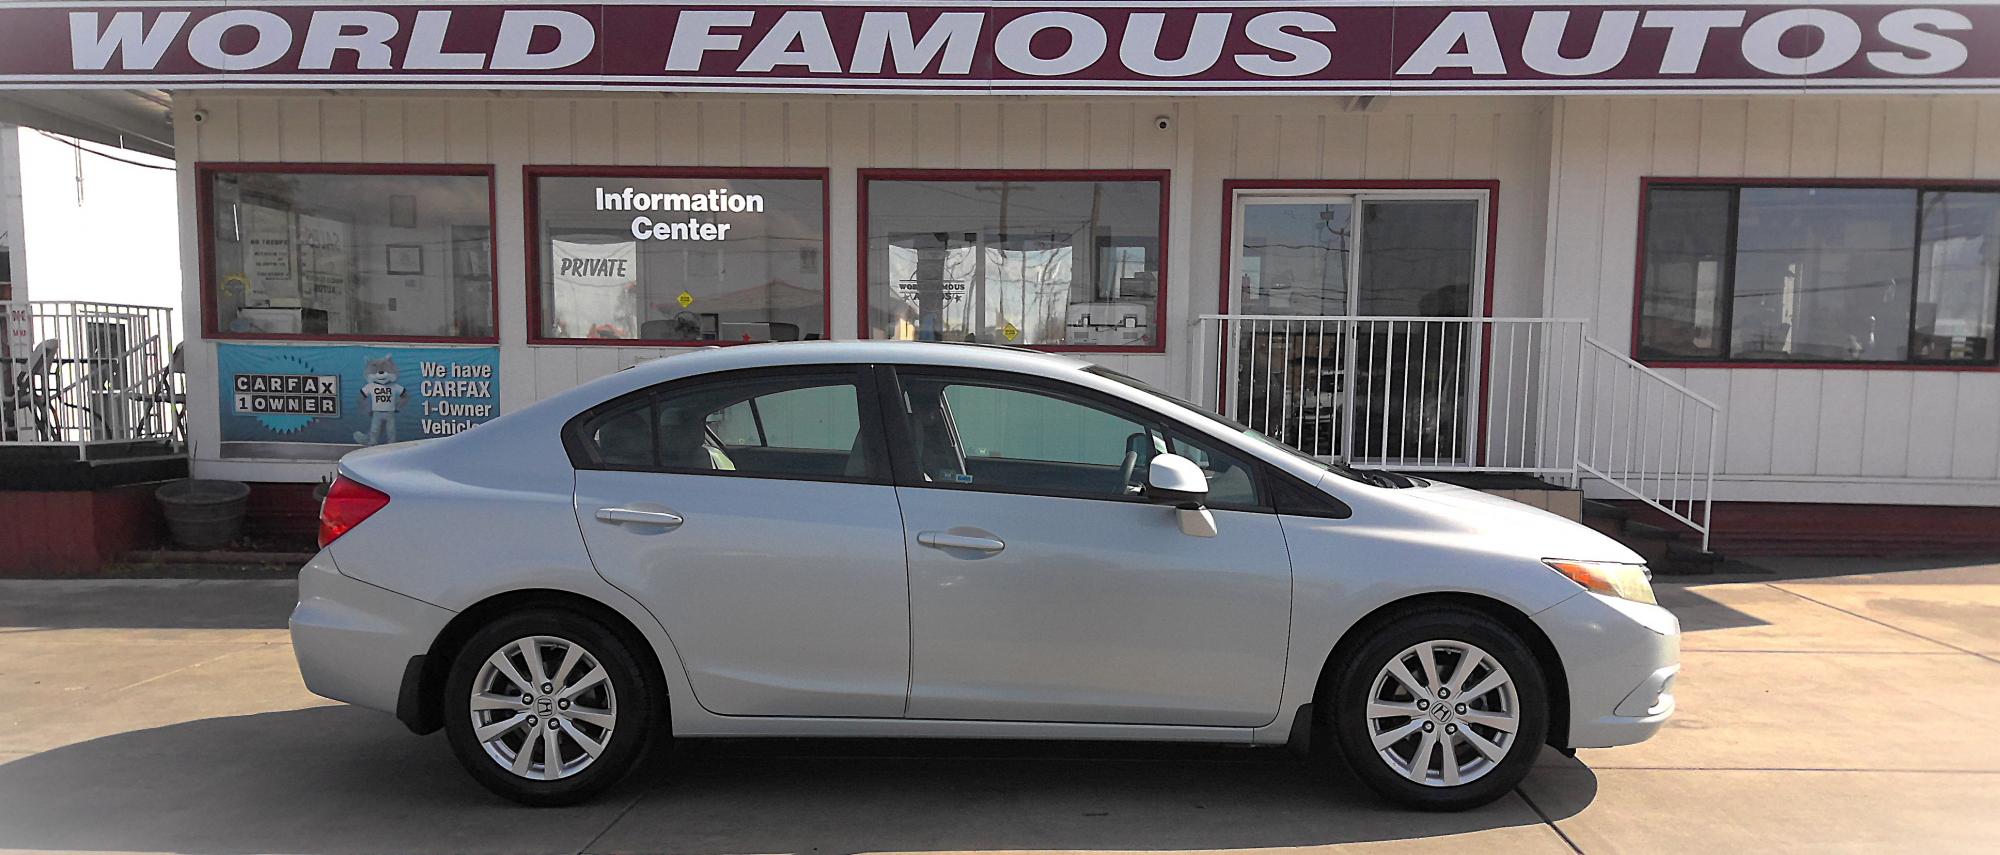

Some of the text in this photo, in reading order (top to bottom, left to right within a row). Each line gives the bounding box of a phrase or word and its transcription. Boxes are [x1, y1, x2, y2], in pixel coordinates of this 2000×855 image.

[69, 8, 1972, 77] WORLD FAMOUS AUTOS
[595, 188, 764, 213] Information
[631, 216, 731, 241] Center
[560, 257, 627, 278] PRIVATE
[421, 361, 492, 379] We have
[237, 376, 333, 394] CARFAX
[374, 387, 392, 395] CAR
[420, 381, 491, 398] CARFAX
[239, 397, 334, 412] 1 OWNER
[375, 395, 392, 404] FOX
[422, 400, 492, 417] 1-Owner
[421, 419, 481, 435] Vehicl
